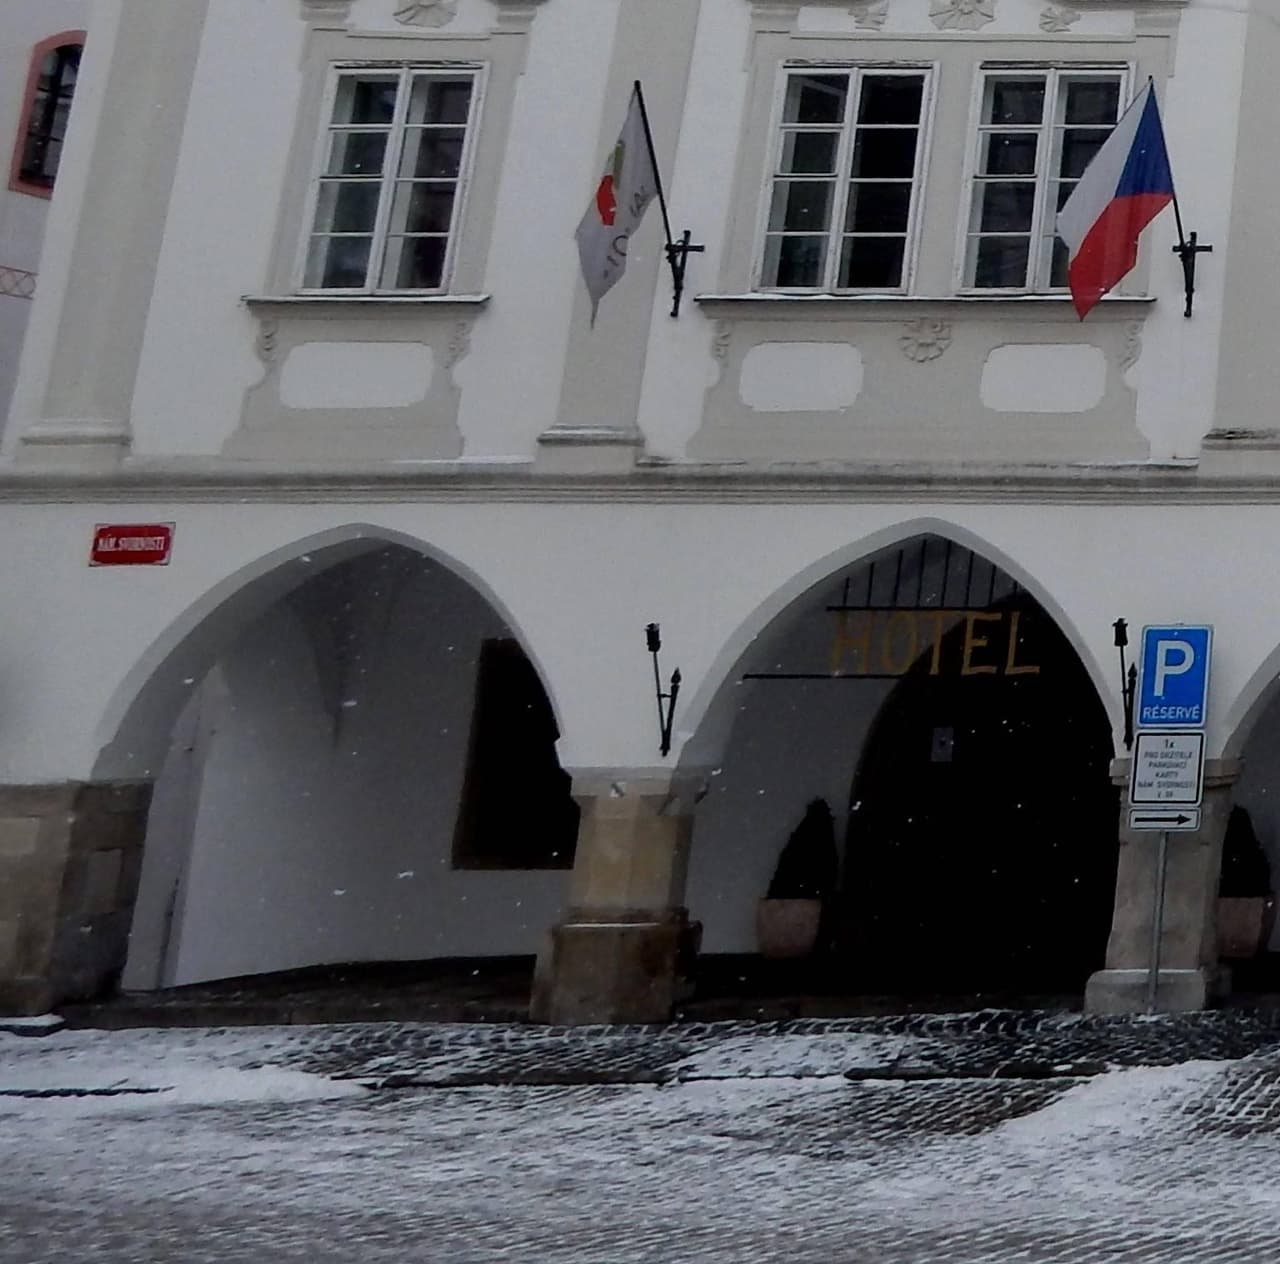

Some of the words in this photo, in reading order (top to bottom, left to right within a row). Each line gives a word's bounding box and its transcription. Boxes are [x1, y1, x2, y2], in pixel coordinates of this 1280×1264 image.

[832, 610, 1040, 675] HOTEL
[1154, 640, 1194, 696] P
[1143, 704, 1200, 719] RÉSERVÉ
